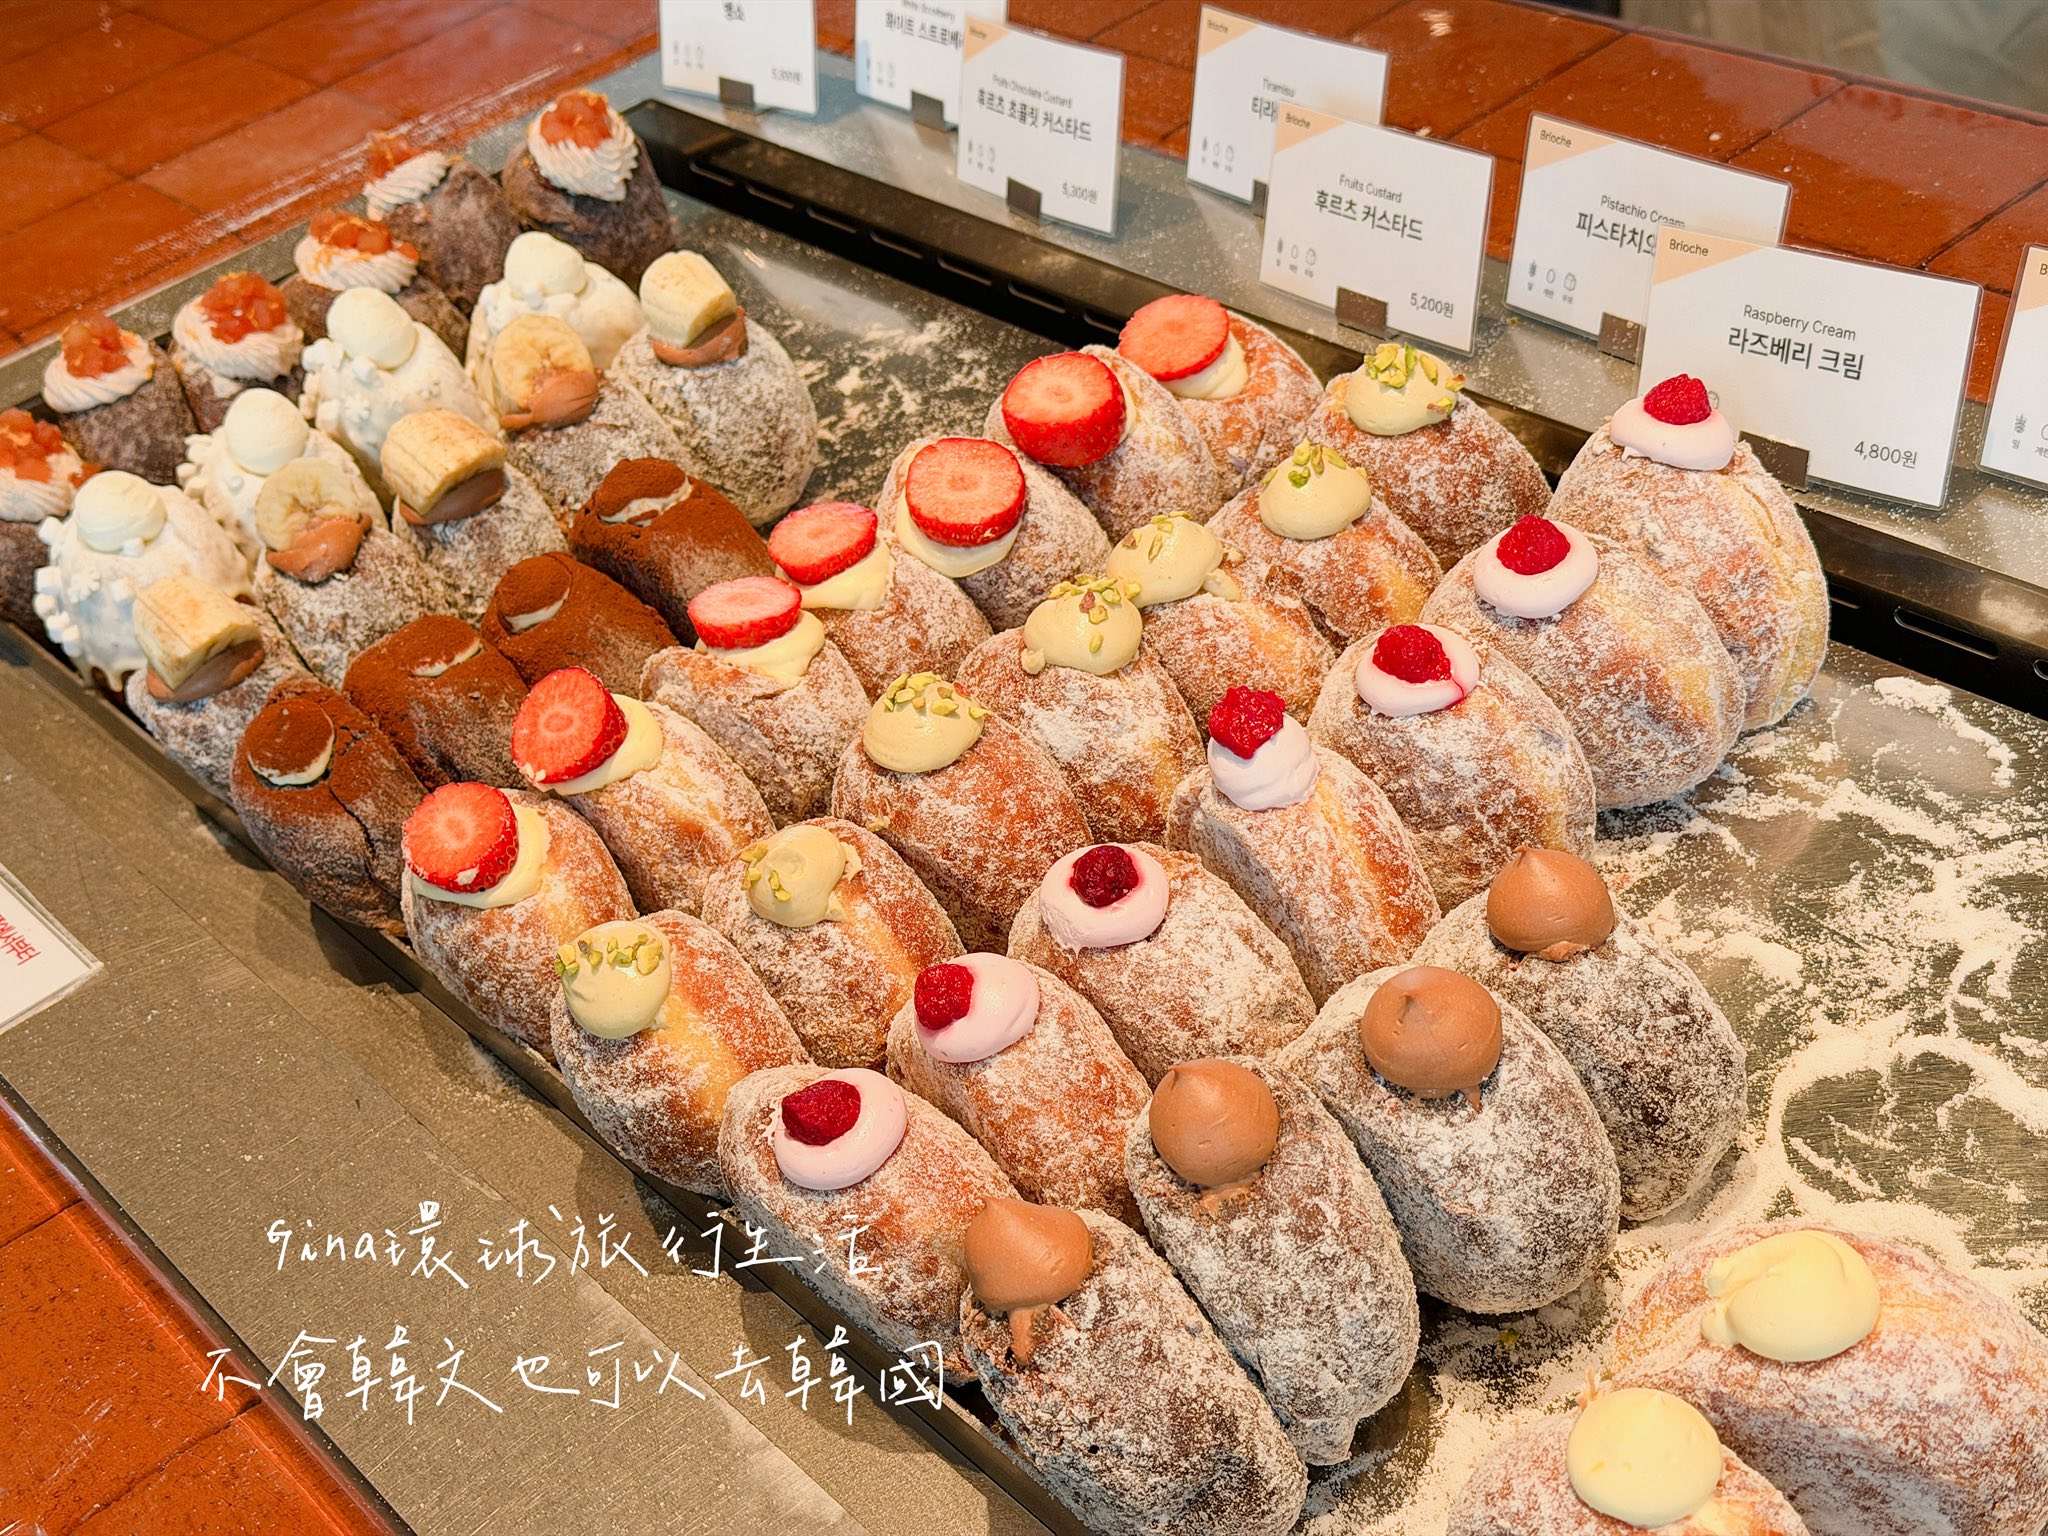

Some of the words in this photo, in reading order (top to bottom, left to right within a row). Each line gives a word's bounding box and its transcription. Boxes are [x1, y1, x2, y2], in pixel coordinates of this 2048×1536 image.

[885, 10, 915, 36] 화이트
[1262, 78, 1296, 97] Tiramisu
[977, 87, 1004, 115] 후르츠
[1042, 111, 1092, 141] 커스타드
[1251, 97, 1278, 122] 티라
[1285, 113, 1311, 129] Brioche
[1539, 130, 1572, 148] Brioche
[1339, 174, 1364, 193] Fruits
[1366, 183, 1403, 203] Custard
[1315, 190, 1357, 221] 후르츠
[1362, 204, 1423, 240] 커스타드
[1600, 195, 1648, 220] Pistachio
[1668, 238, 1709, 257] Brioche
[2039, 263, 2048, 276] B
[1410, 292, 1454, 319] 5,200원
[1743, 304, 1809, 340] Raspberry
[1812, 319, 1857, 341] Cream
[1727, 326, 1813, 370] 라즈베리
[1818, 348, 1865, 381] 크림
[1854, 441, 1918, 470] 4,800원
